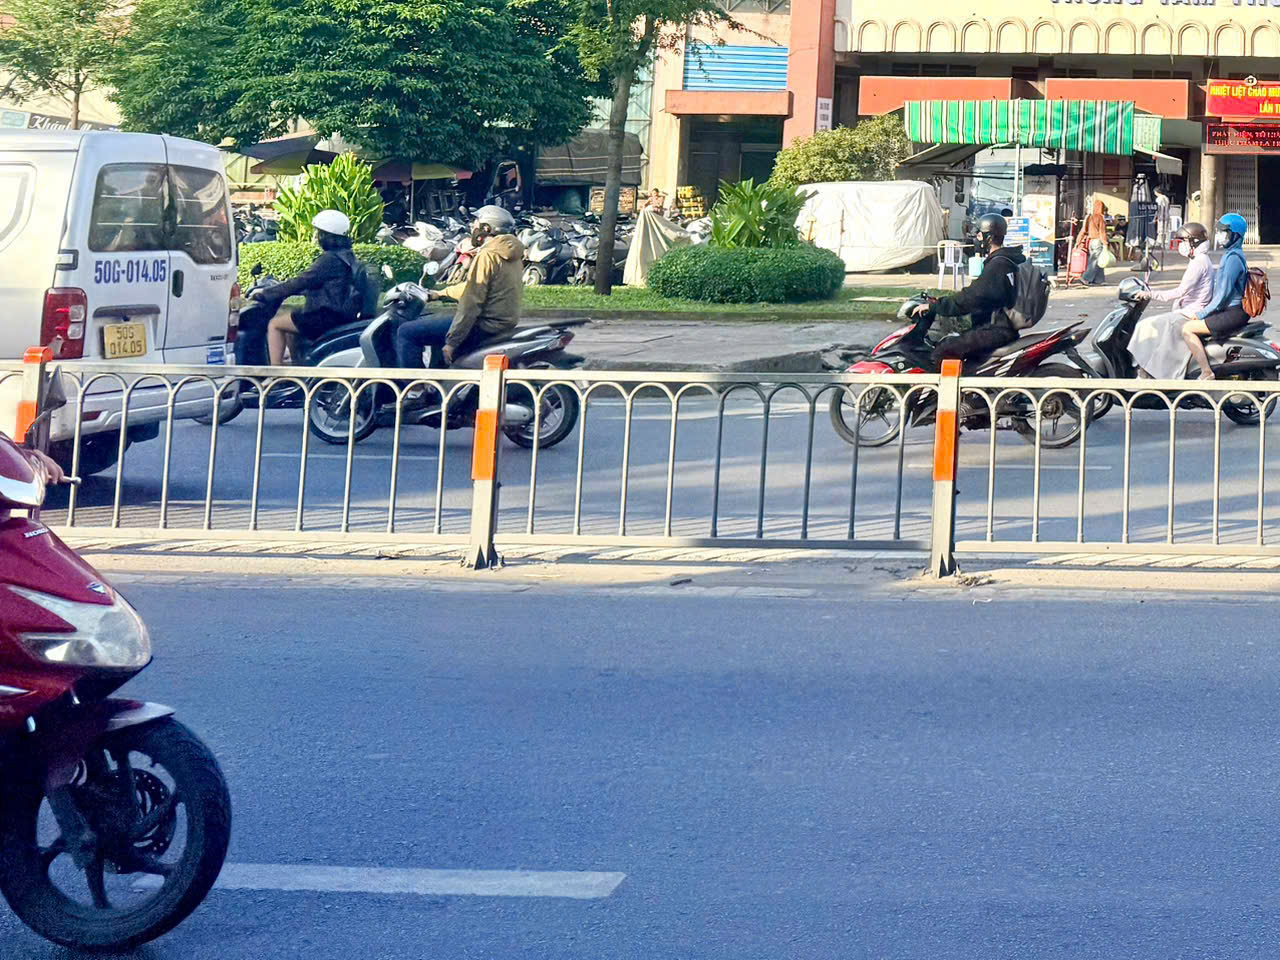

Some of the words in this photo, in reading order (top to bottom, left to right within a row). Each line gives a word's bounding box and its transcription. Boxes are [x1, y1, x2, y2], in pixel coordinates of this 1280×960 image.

[94, 259, 167, 284] 50G-014.05
[116, 326, 135, 340] 50G
[109, 340, 143, 355] 014.05
